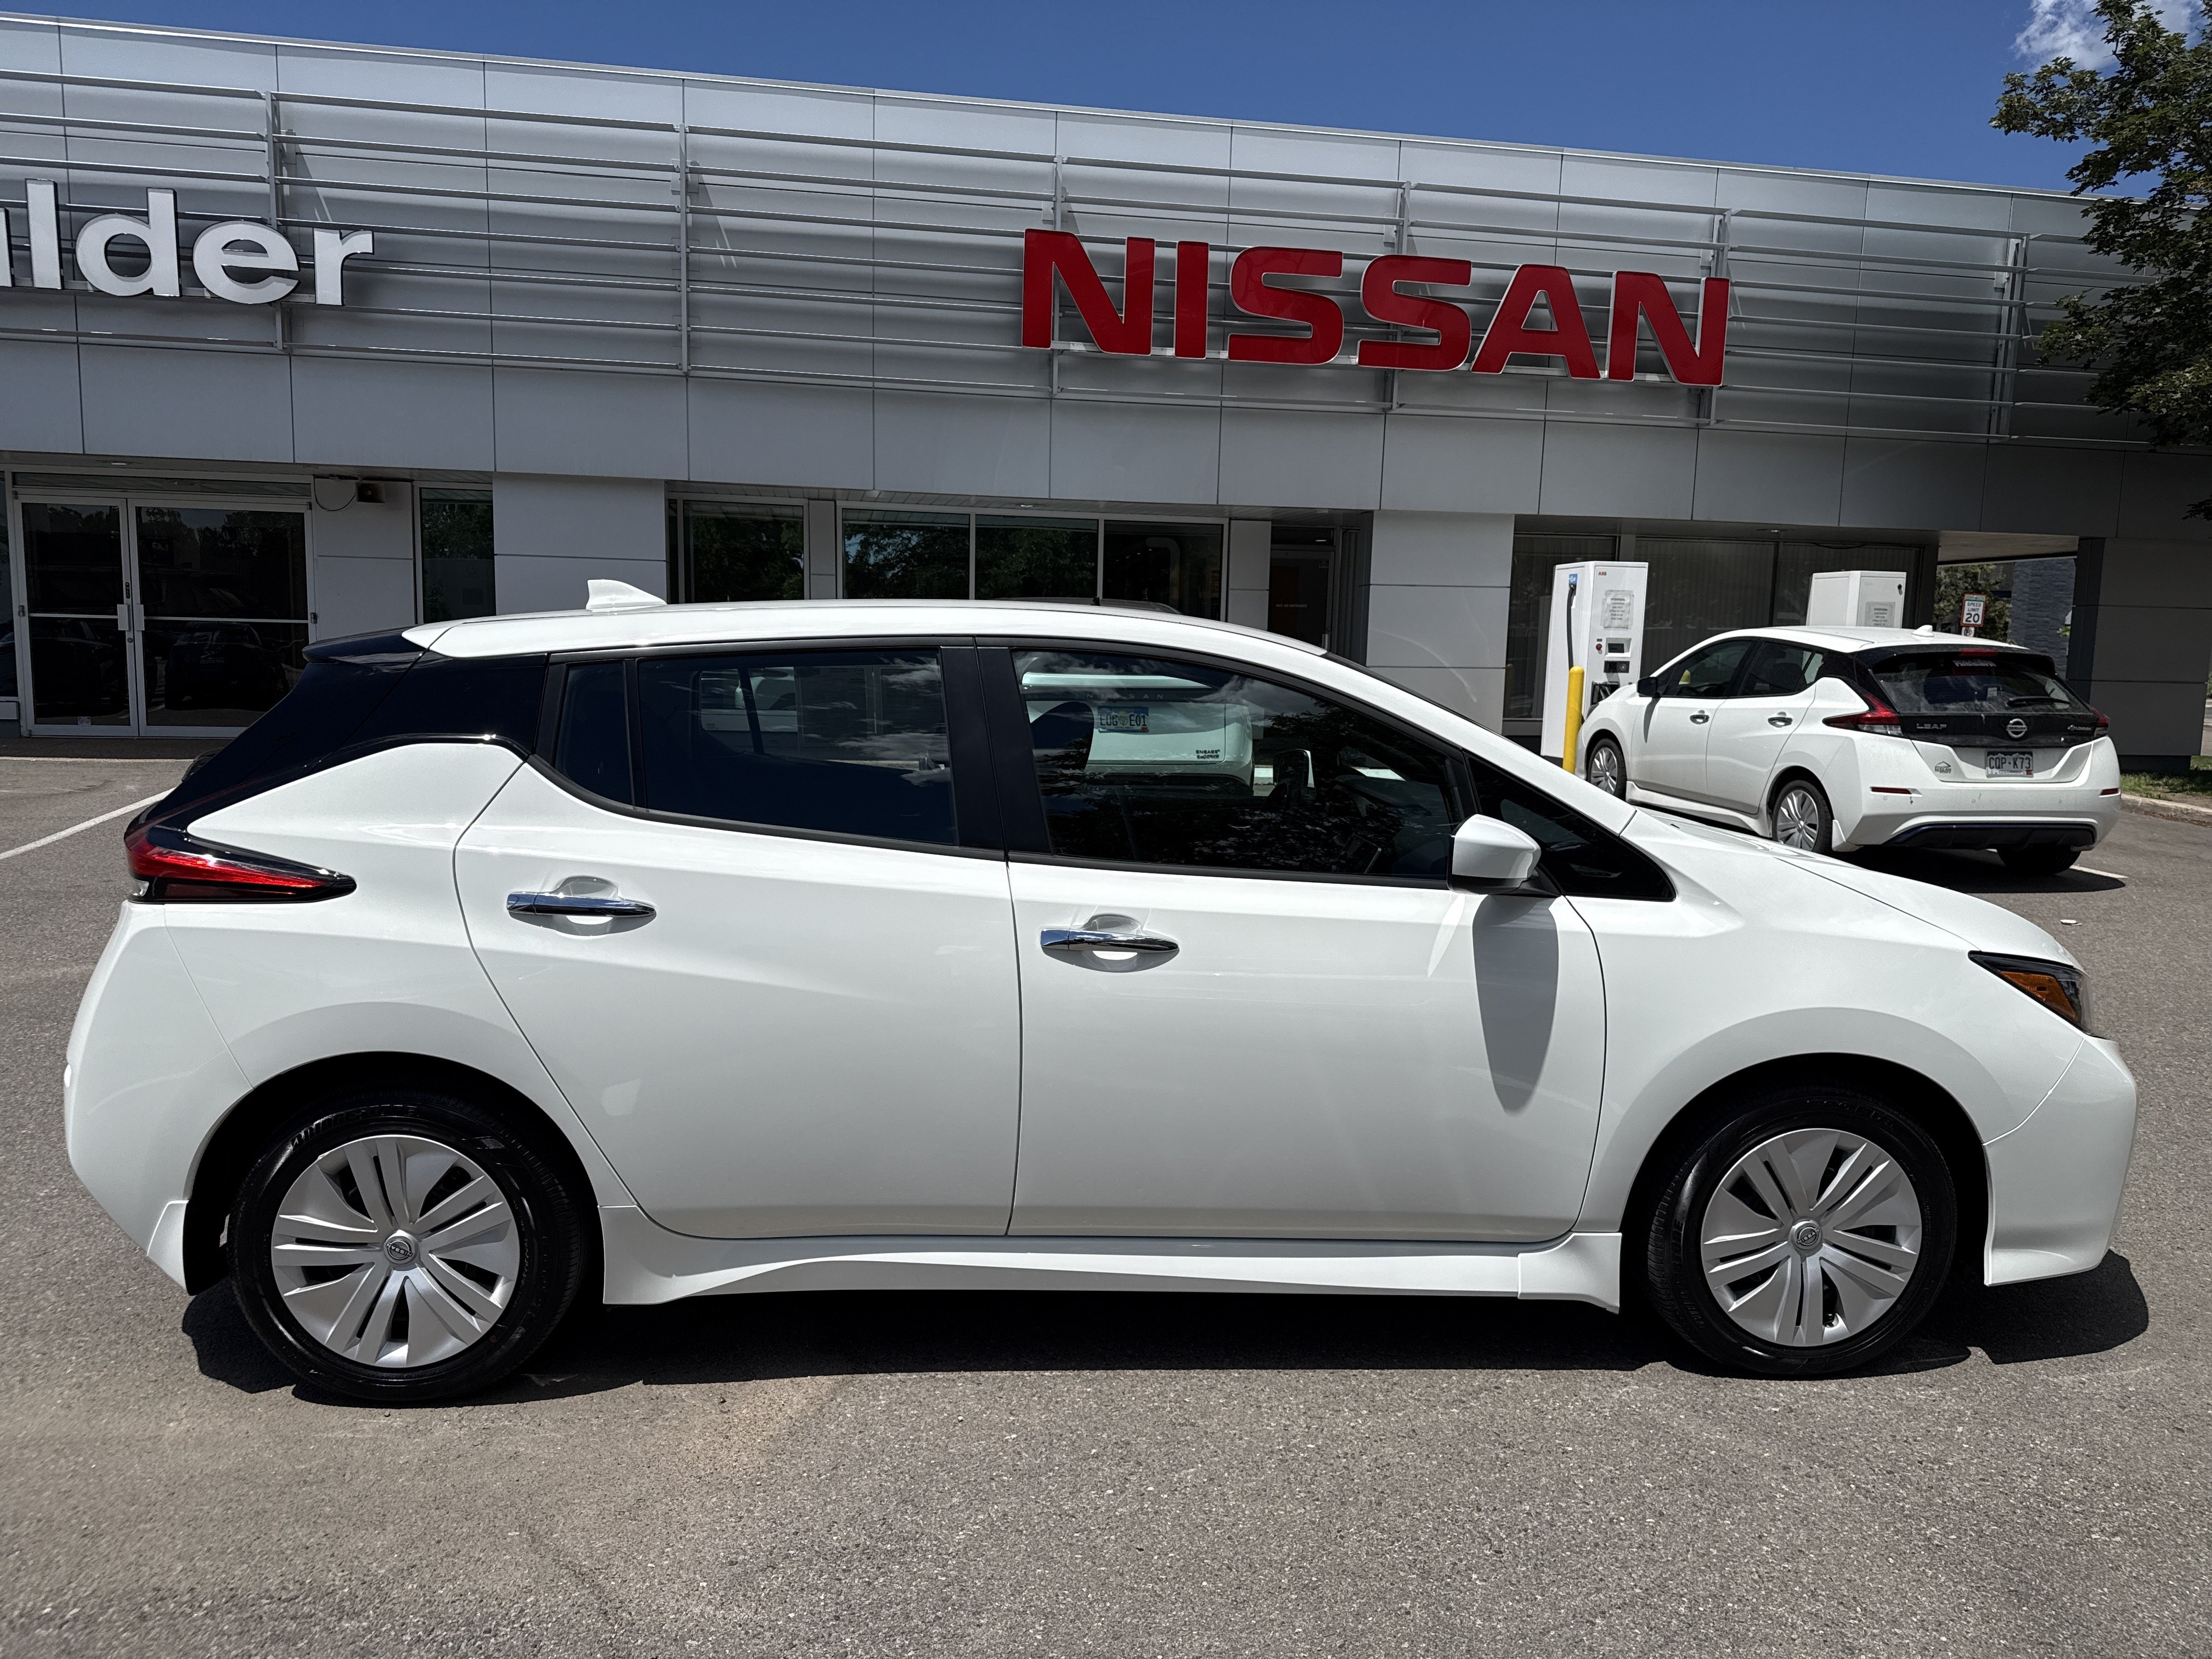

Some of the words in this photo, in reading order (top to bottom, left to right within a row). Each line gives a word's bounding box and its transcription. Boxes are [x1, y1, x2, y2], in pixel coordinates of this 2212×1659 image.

[1021, 228, 1730, 386] NISSAN
[1965, 613, 1979, 623] 20
[1797, 1228, 1819, 1244] NISSAN
[386, 1243, 412, 1256] NISSAN
